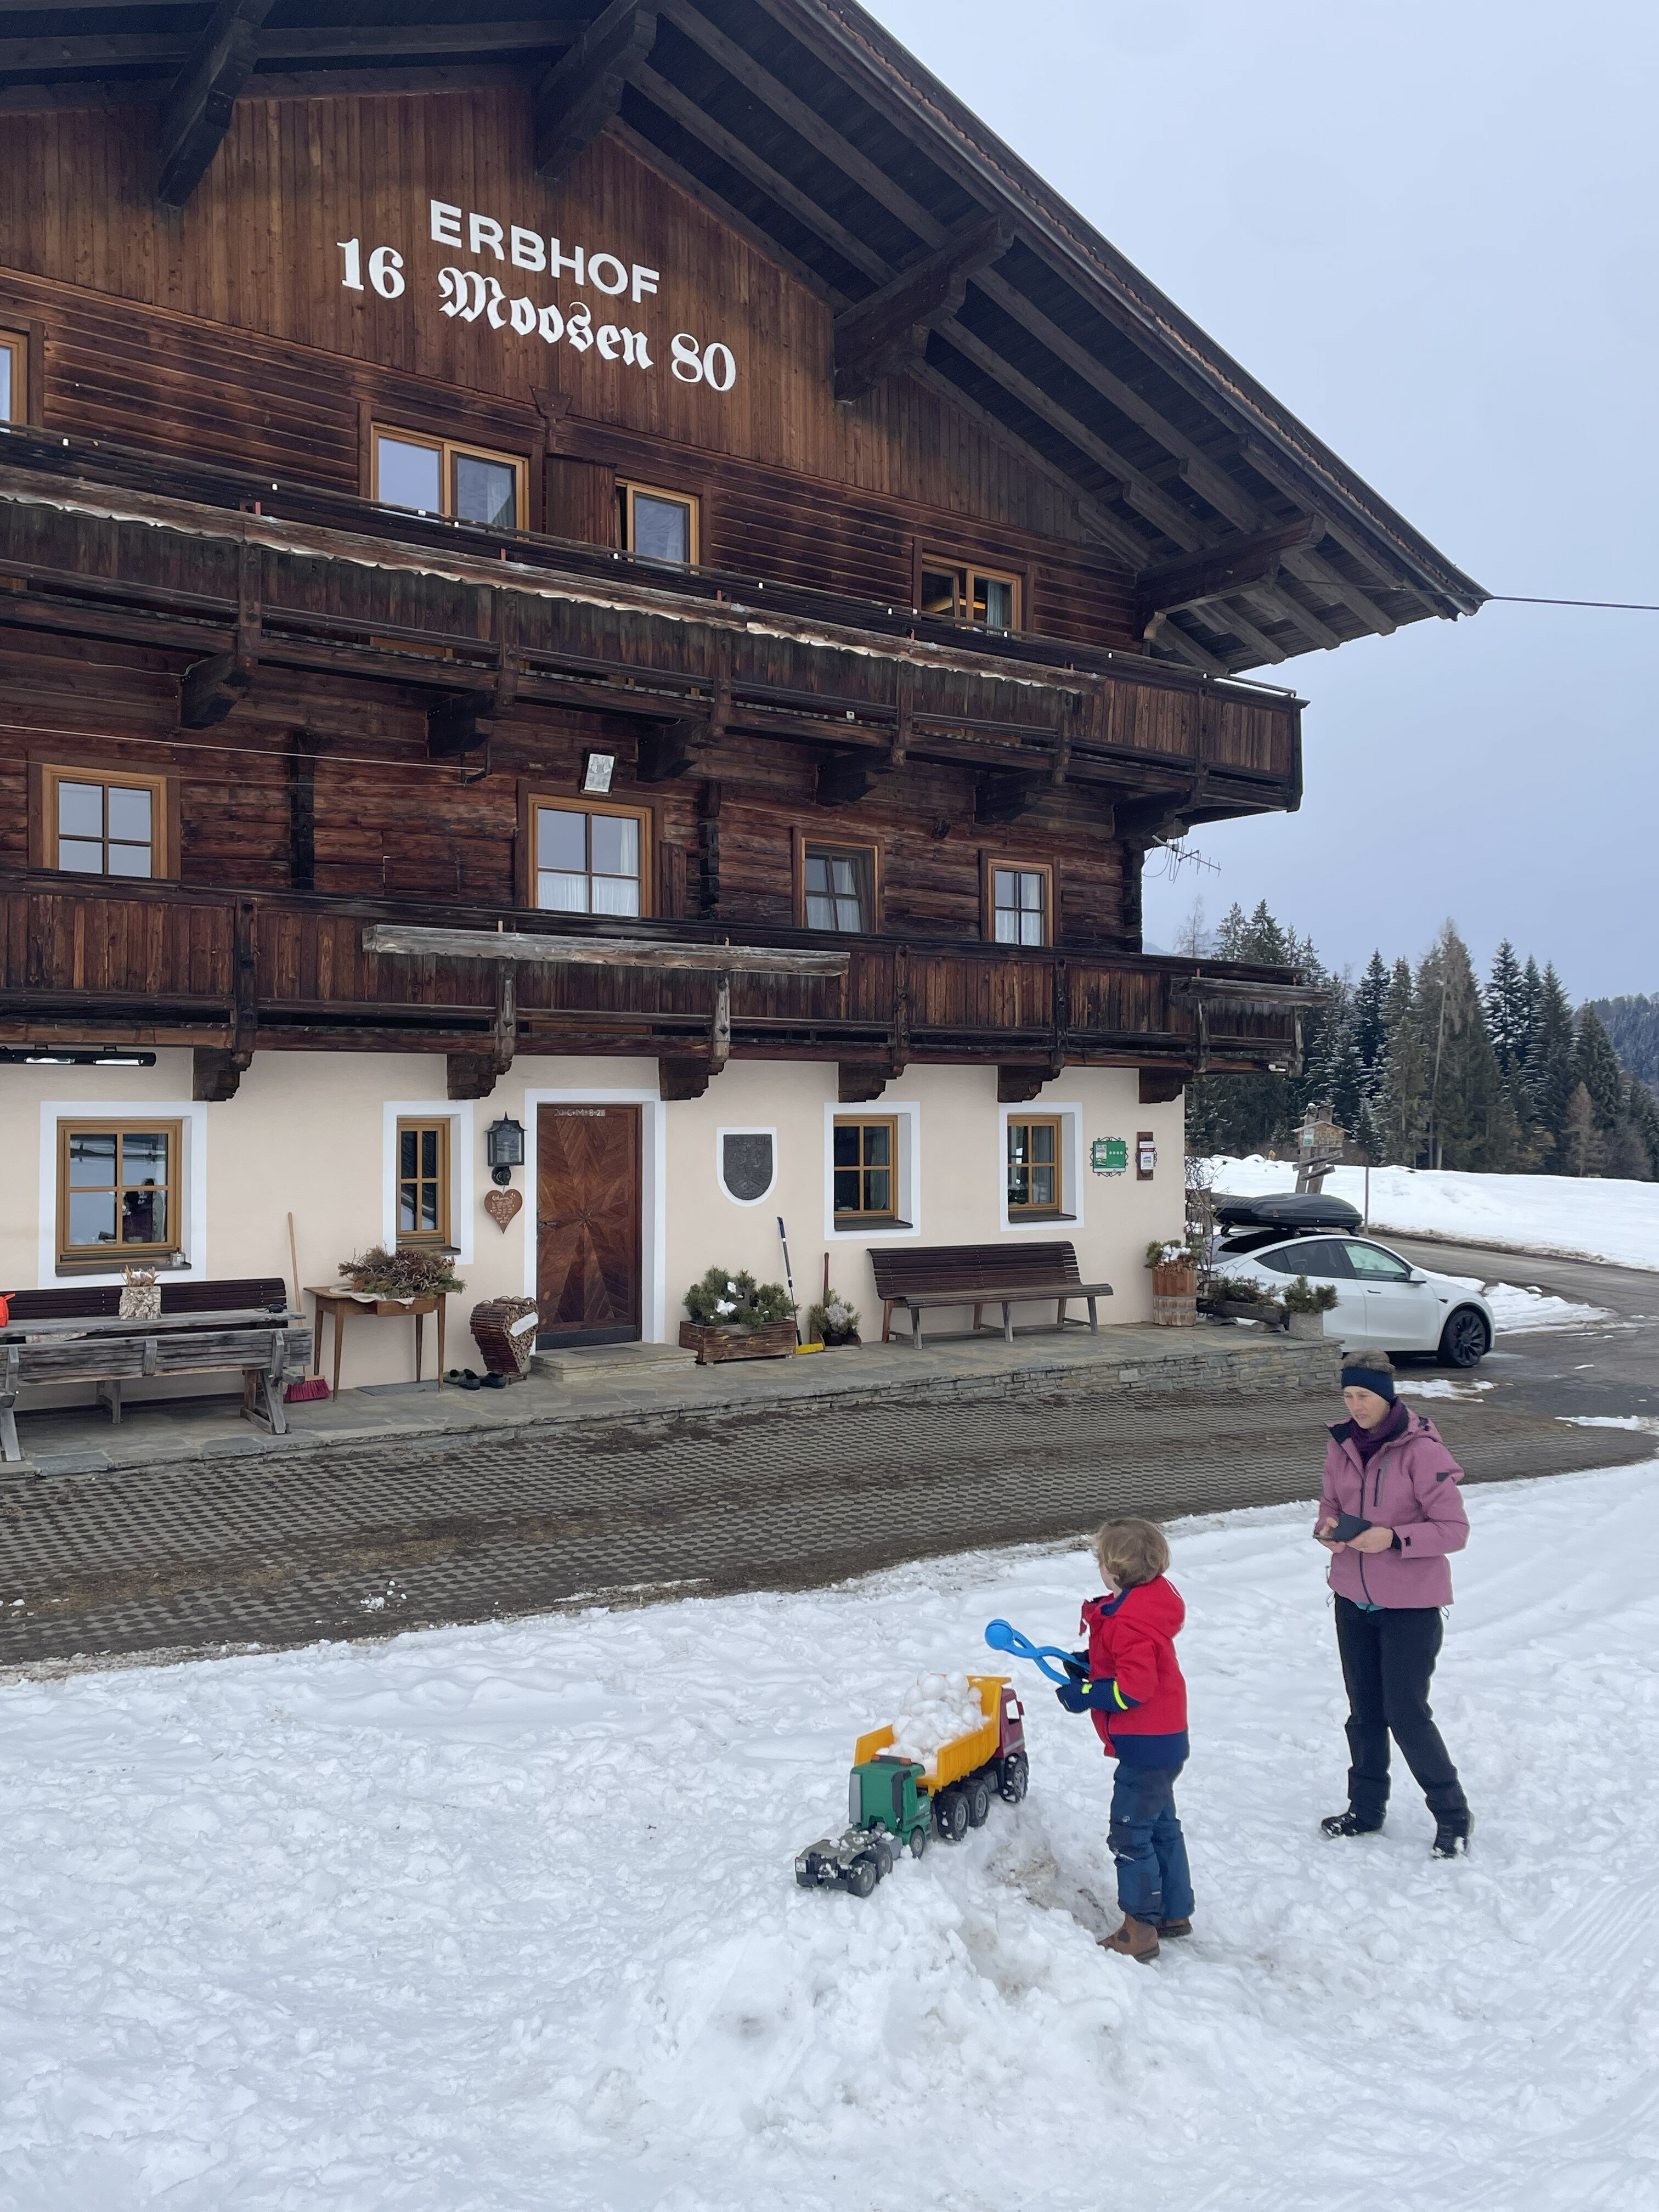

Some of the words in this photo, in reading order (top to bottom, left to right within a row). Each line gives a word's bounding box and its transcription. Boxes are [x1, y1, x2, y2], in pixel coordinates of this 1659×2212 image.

[336, 238, 405, 298] 16
[438, 267, 654, 370] Moosen
[671, 333, 736, 391] 80
[430, 199, 659, 303] ERBHOF
